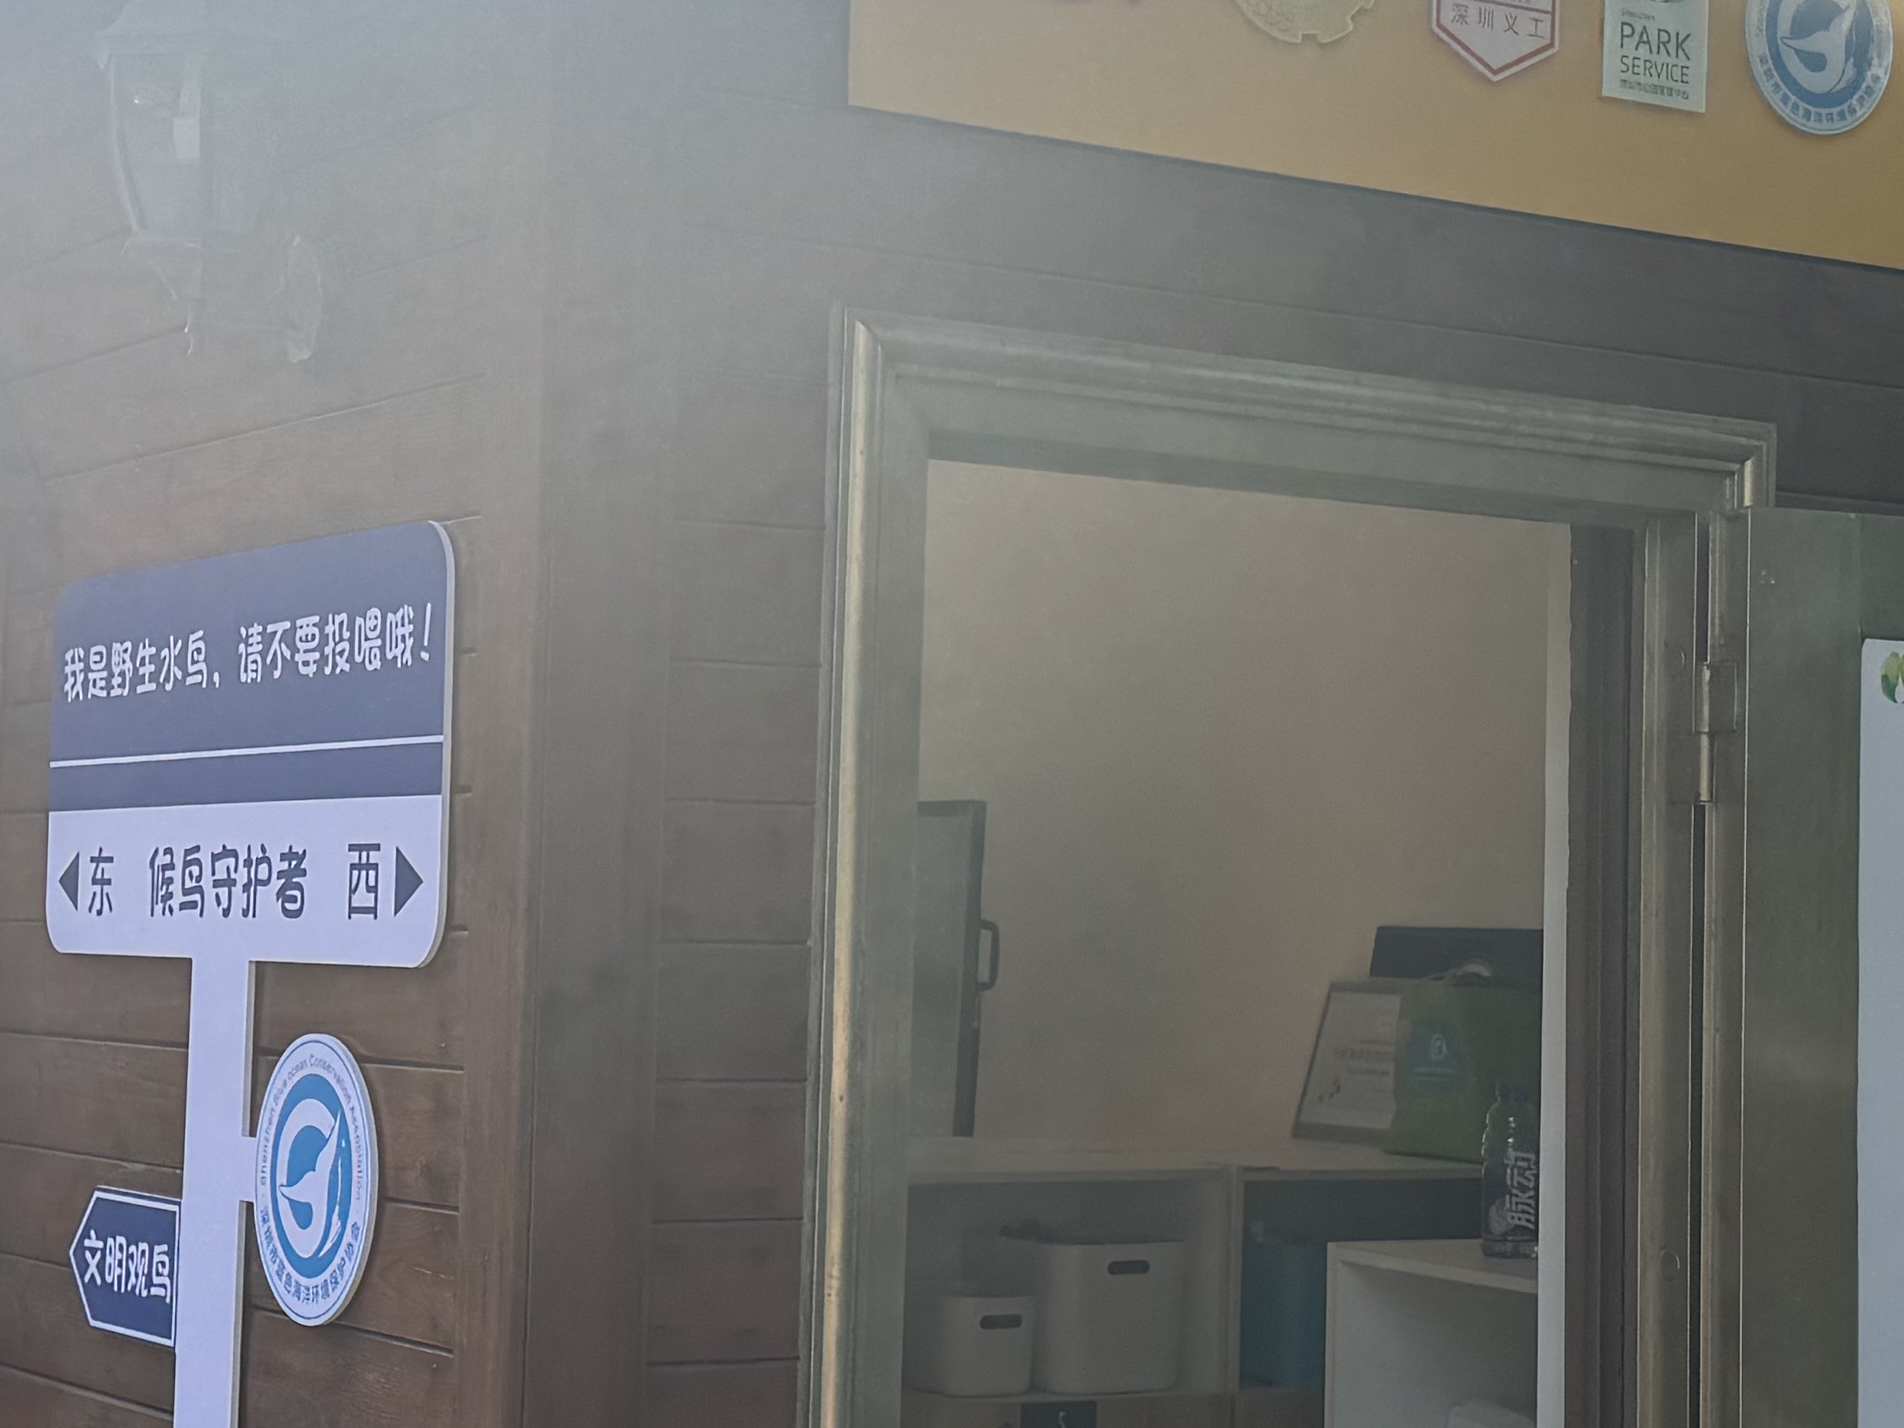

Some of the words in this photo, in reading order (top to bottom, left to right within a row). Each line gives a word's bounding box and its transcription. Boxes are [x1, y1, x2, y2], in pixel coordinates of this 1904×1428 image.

[1451, 2, 1545, 39] 深圳义工
[1620, 21, 1691, 61] PARK
[1620, 54, 1690, 84] SERVICE
[63, 602, 433, 703] 我是野生水鸟，请不要投喂哦！
[88, 846, 114, 917] 东
[149, 844, 308, 919] 候鸟守护者
[347, 843, 382, 920] 西
[1504, 1149, 1537, 1229] 脉动
[83, 1229, 172, 1303] 文明观鸟
